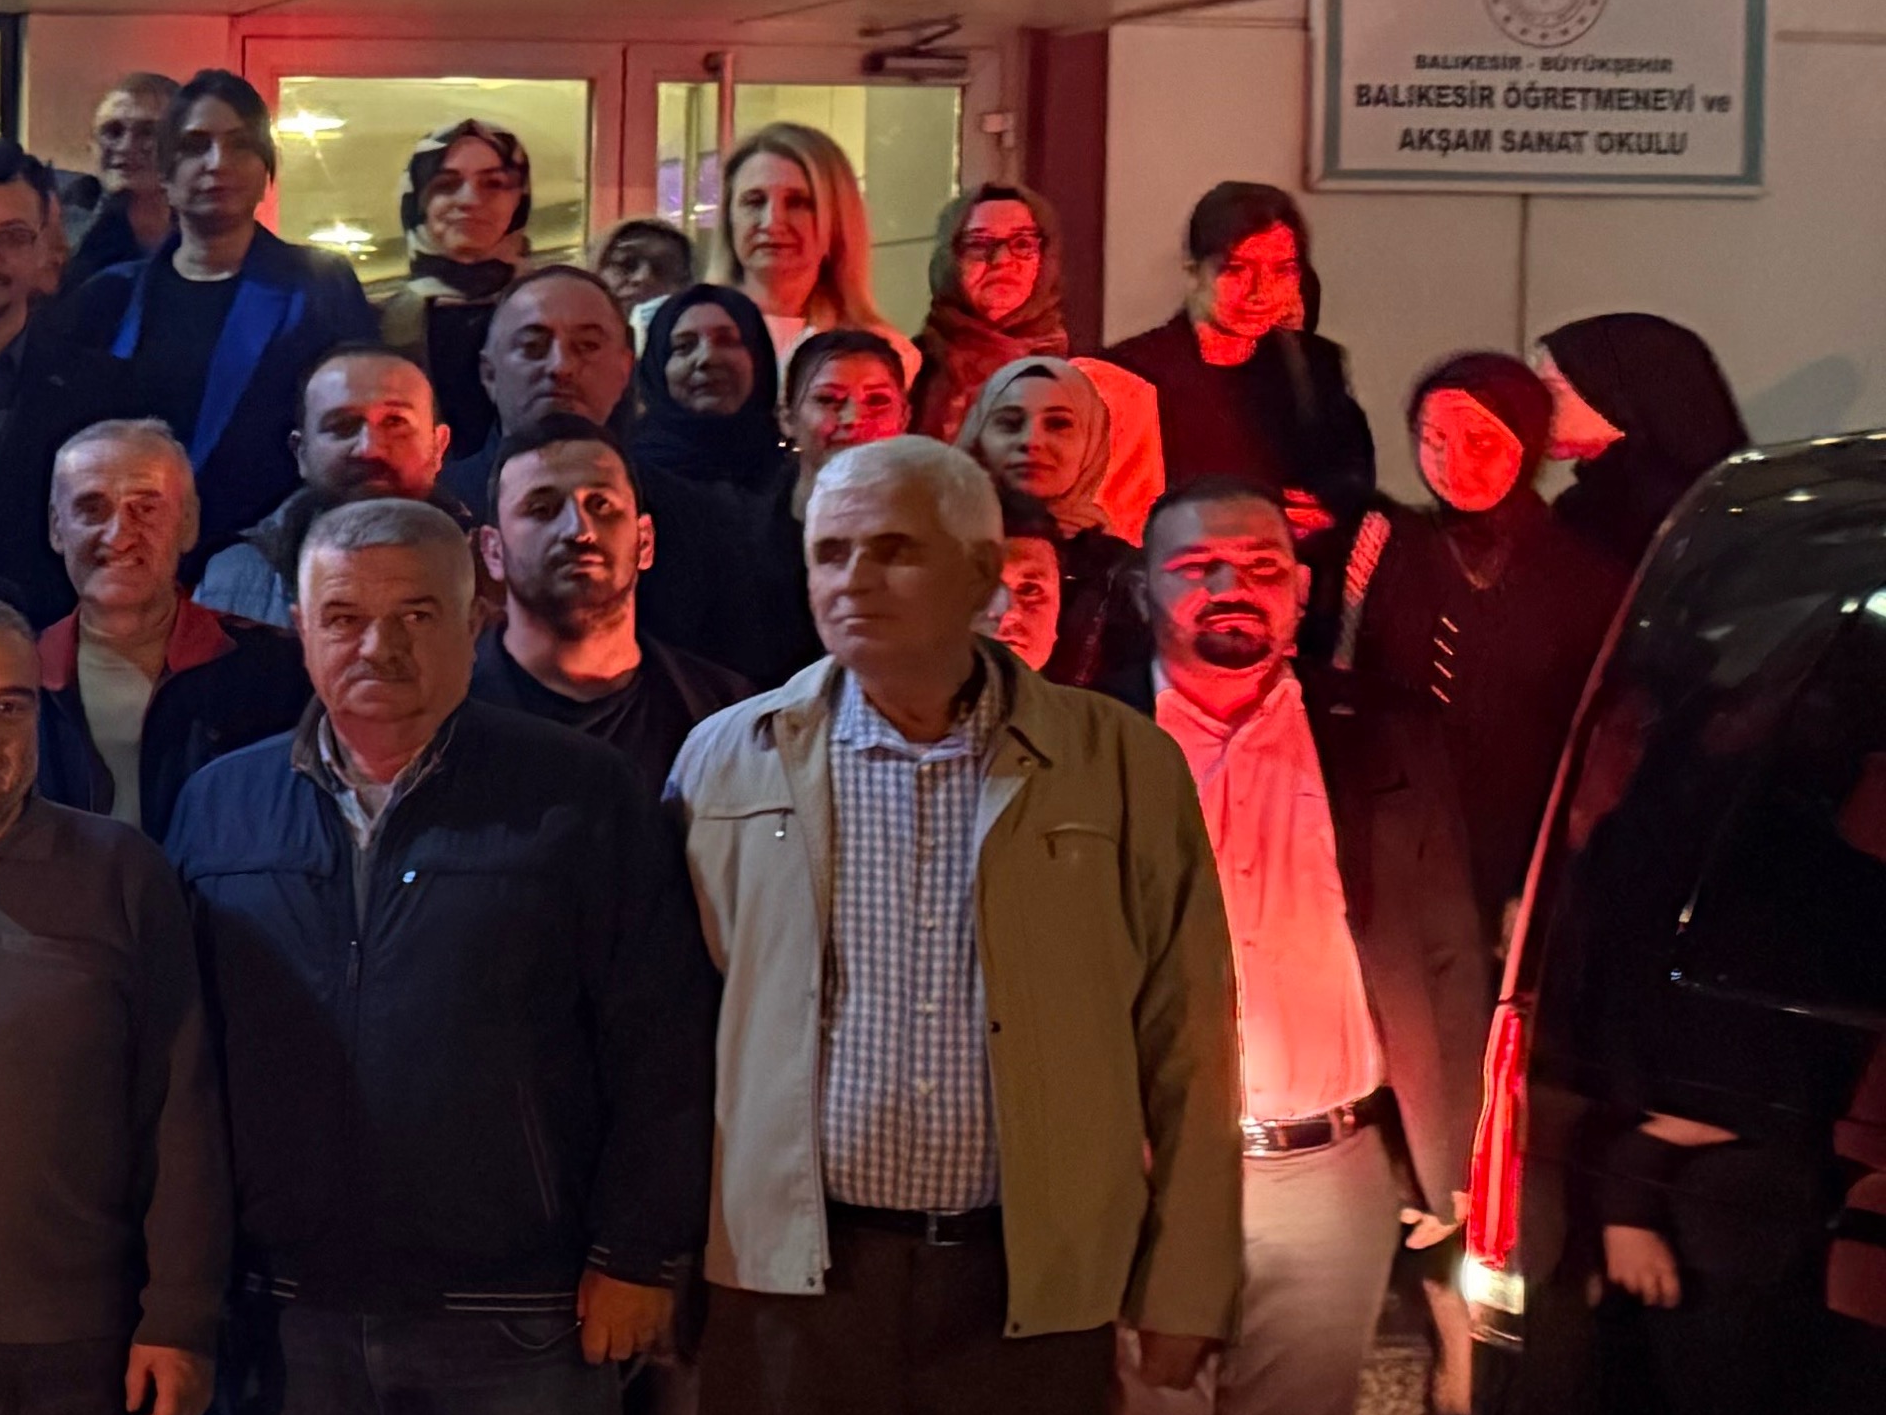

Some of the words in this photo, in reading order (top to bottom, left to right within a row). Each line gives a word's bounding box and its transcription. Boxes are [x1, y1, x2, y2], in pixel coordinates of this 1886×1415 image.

[1356, 80, 1495, 107] BALIKESİR
[1503, 80, 1695, 112] ÖĞRETMENEVİ
[1701, 95, 1731, 113] ve
[1398, 128, 1492, 157] AKŞAM
[1500, 130, 1588, 153] SANAT
[1594, 132, 1687, 155] OKULU
